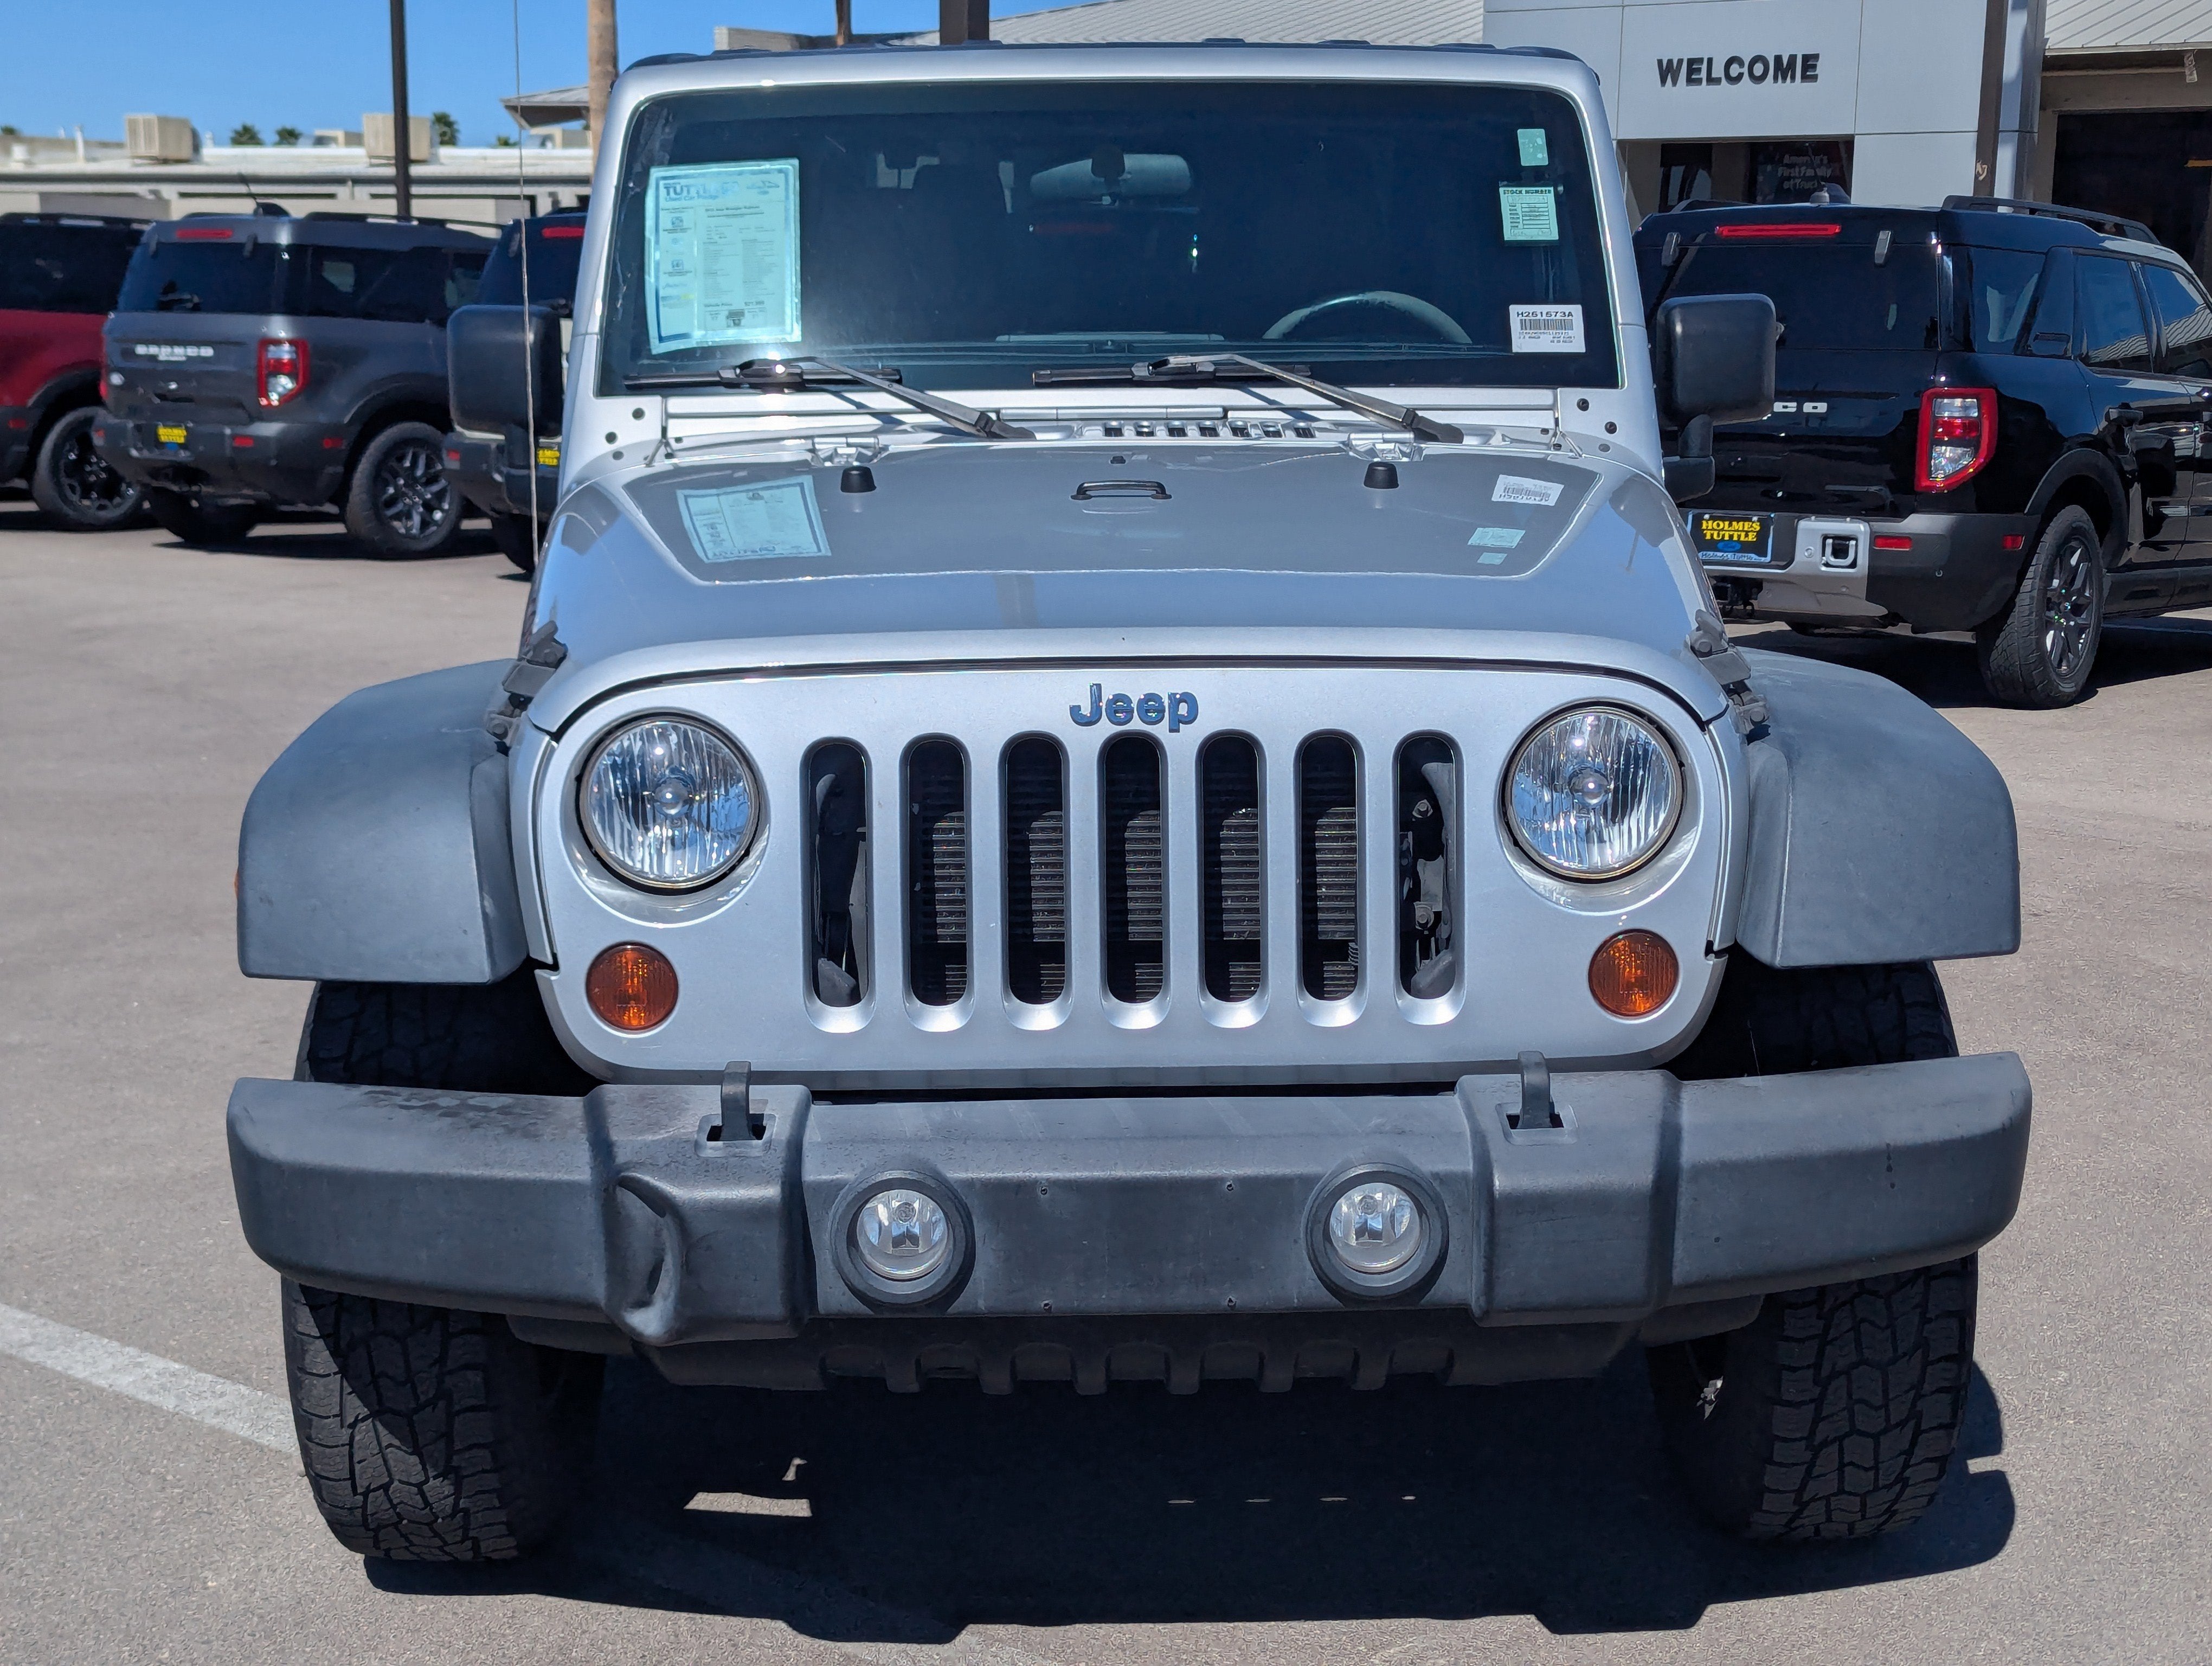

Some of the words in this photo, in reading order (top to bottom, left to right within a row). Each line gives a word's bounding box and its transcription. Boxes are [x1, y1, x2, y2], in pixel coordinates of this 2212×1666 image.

[1657, 53, 1820, 88] WELCOME
[1701, 520, 1760, 531] HOLMES
[1703, 530, 1757, 541] TUTTLE
[1069, 683, 1199, 733] Jeep
